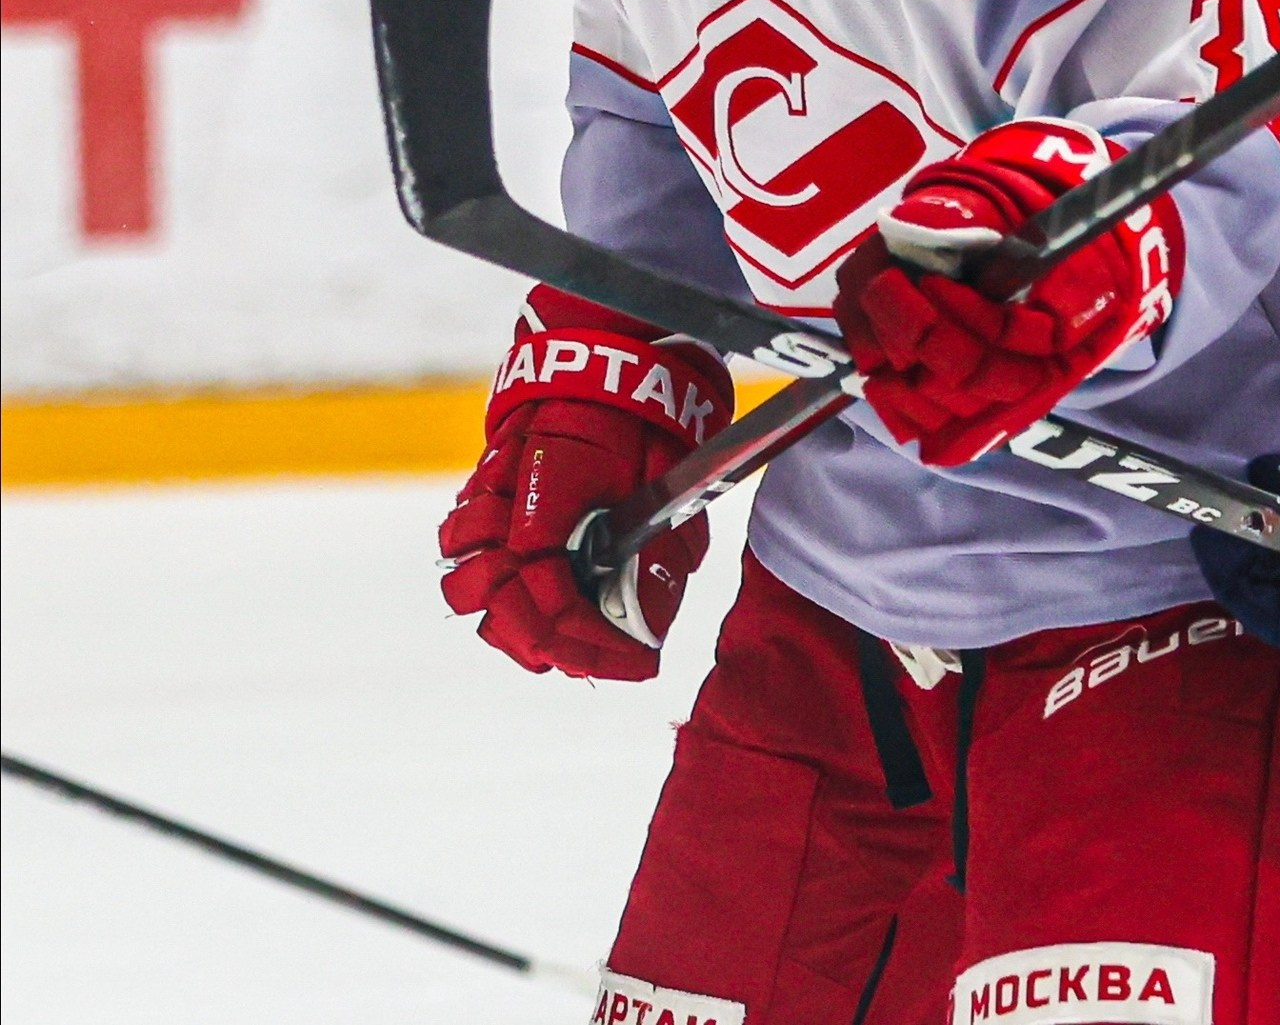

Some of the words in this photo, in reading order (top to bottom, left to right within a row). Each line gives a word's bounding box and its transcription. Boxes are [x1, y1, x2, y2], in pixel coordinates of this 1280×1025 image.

[1166, 496, 1222, 524] BC
[594, 988, 717, 1025] АРТ
[970, 963, 1176, 1024] МОСКВА
